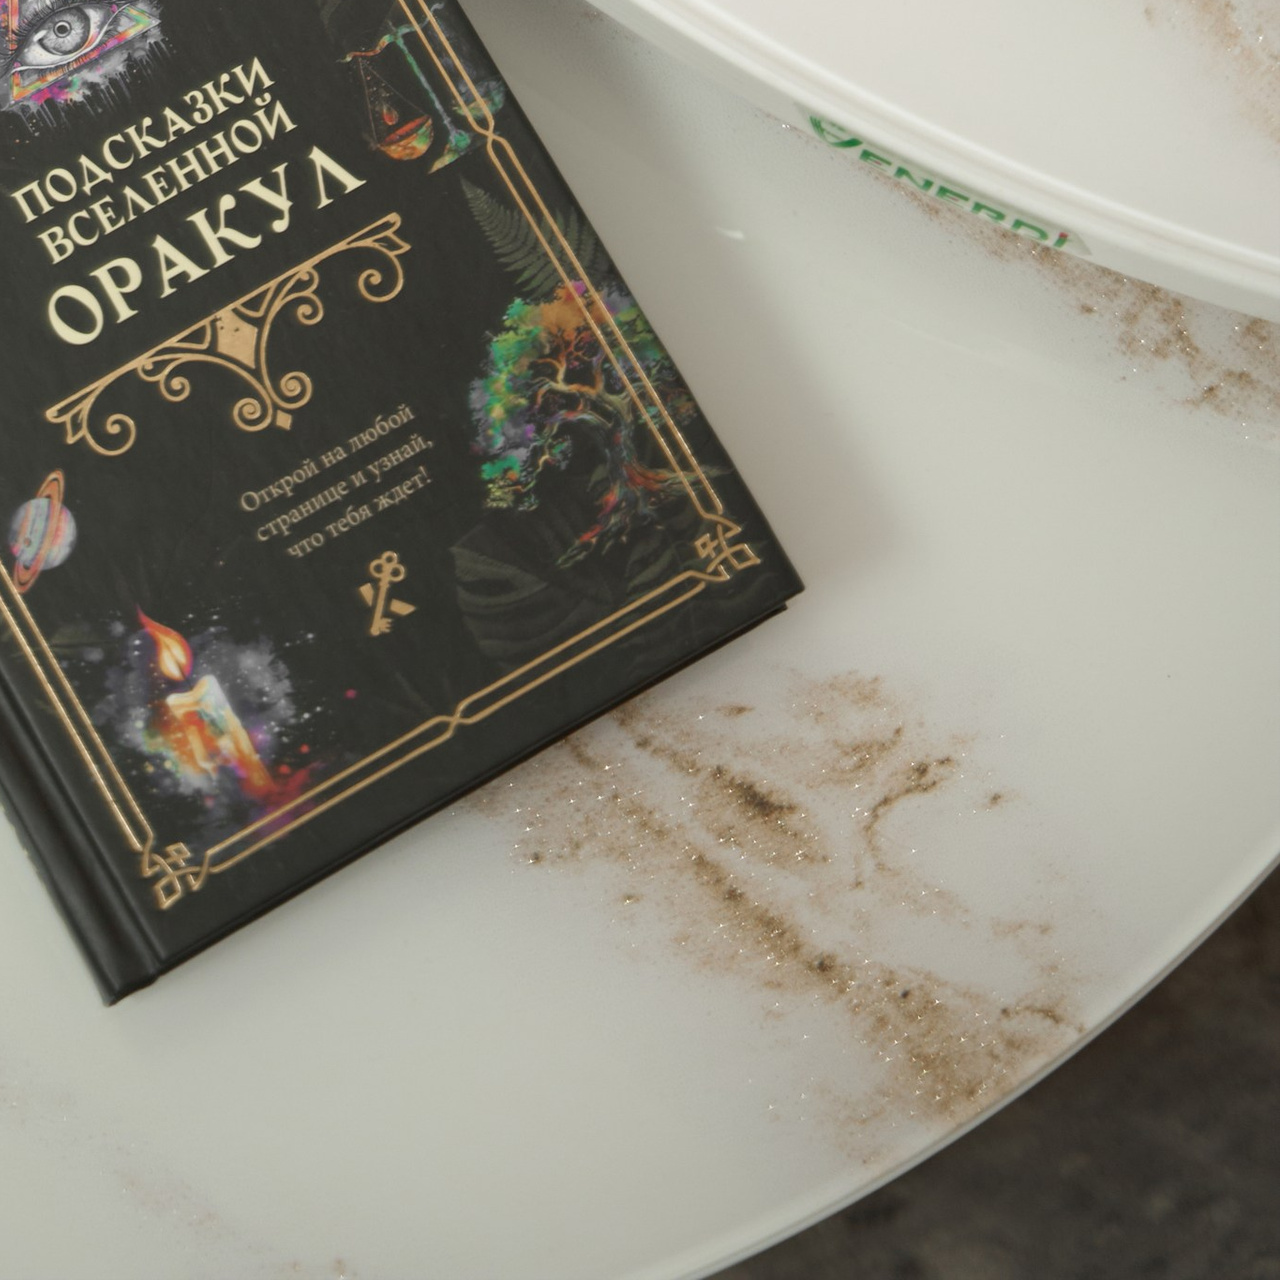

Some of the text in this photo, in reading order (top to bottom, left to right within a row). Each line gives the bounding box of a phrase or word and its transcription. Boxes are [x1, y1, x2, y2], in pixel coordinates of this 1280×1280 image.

[11, 56, 275, 224] ПОДСКАЗКИ
[37, 92, 298, 265] ВСЕЛЕННОЙ
[48, 145, 367, 346] ОРАКУЛ
[240, 403, 415, 511] Открой на любой
[256, 433, 434, 541] странице и узнай,
[286, 465, 432, 559] что тебя ждет!
